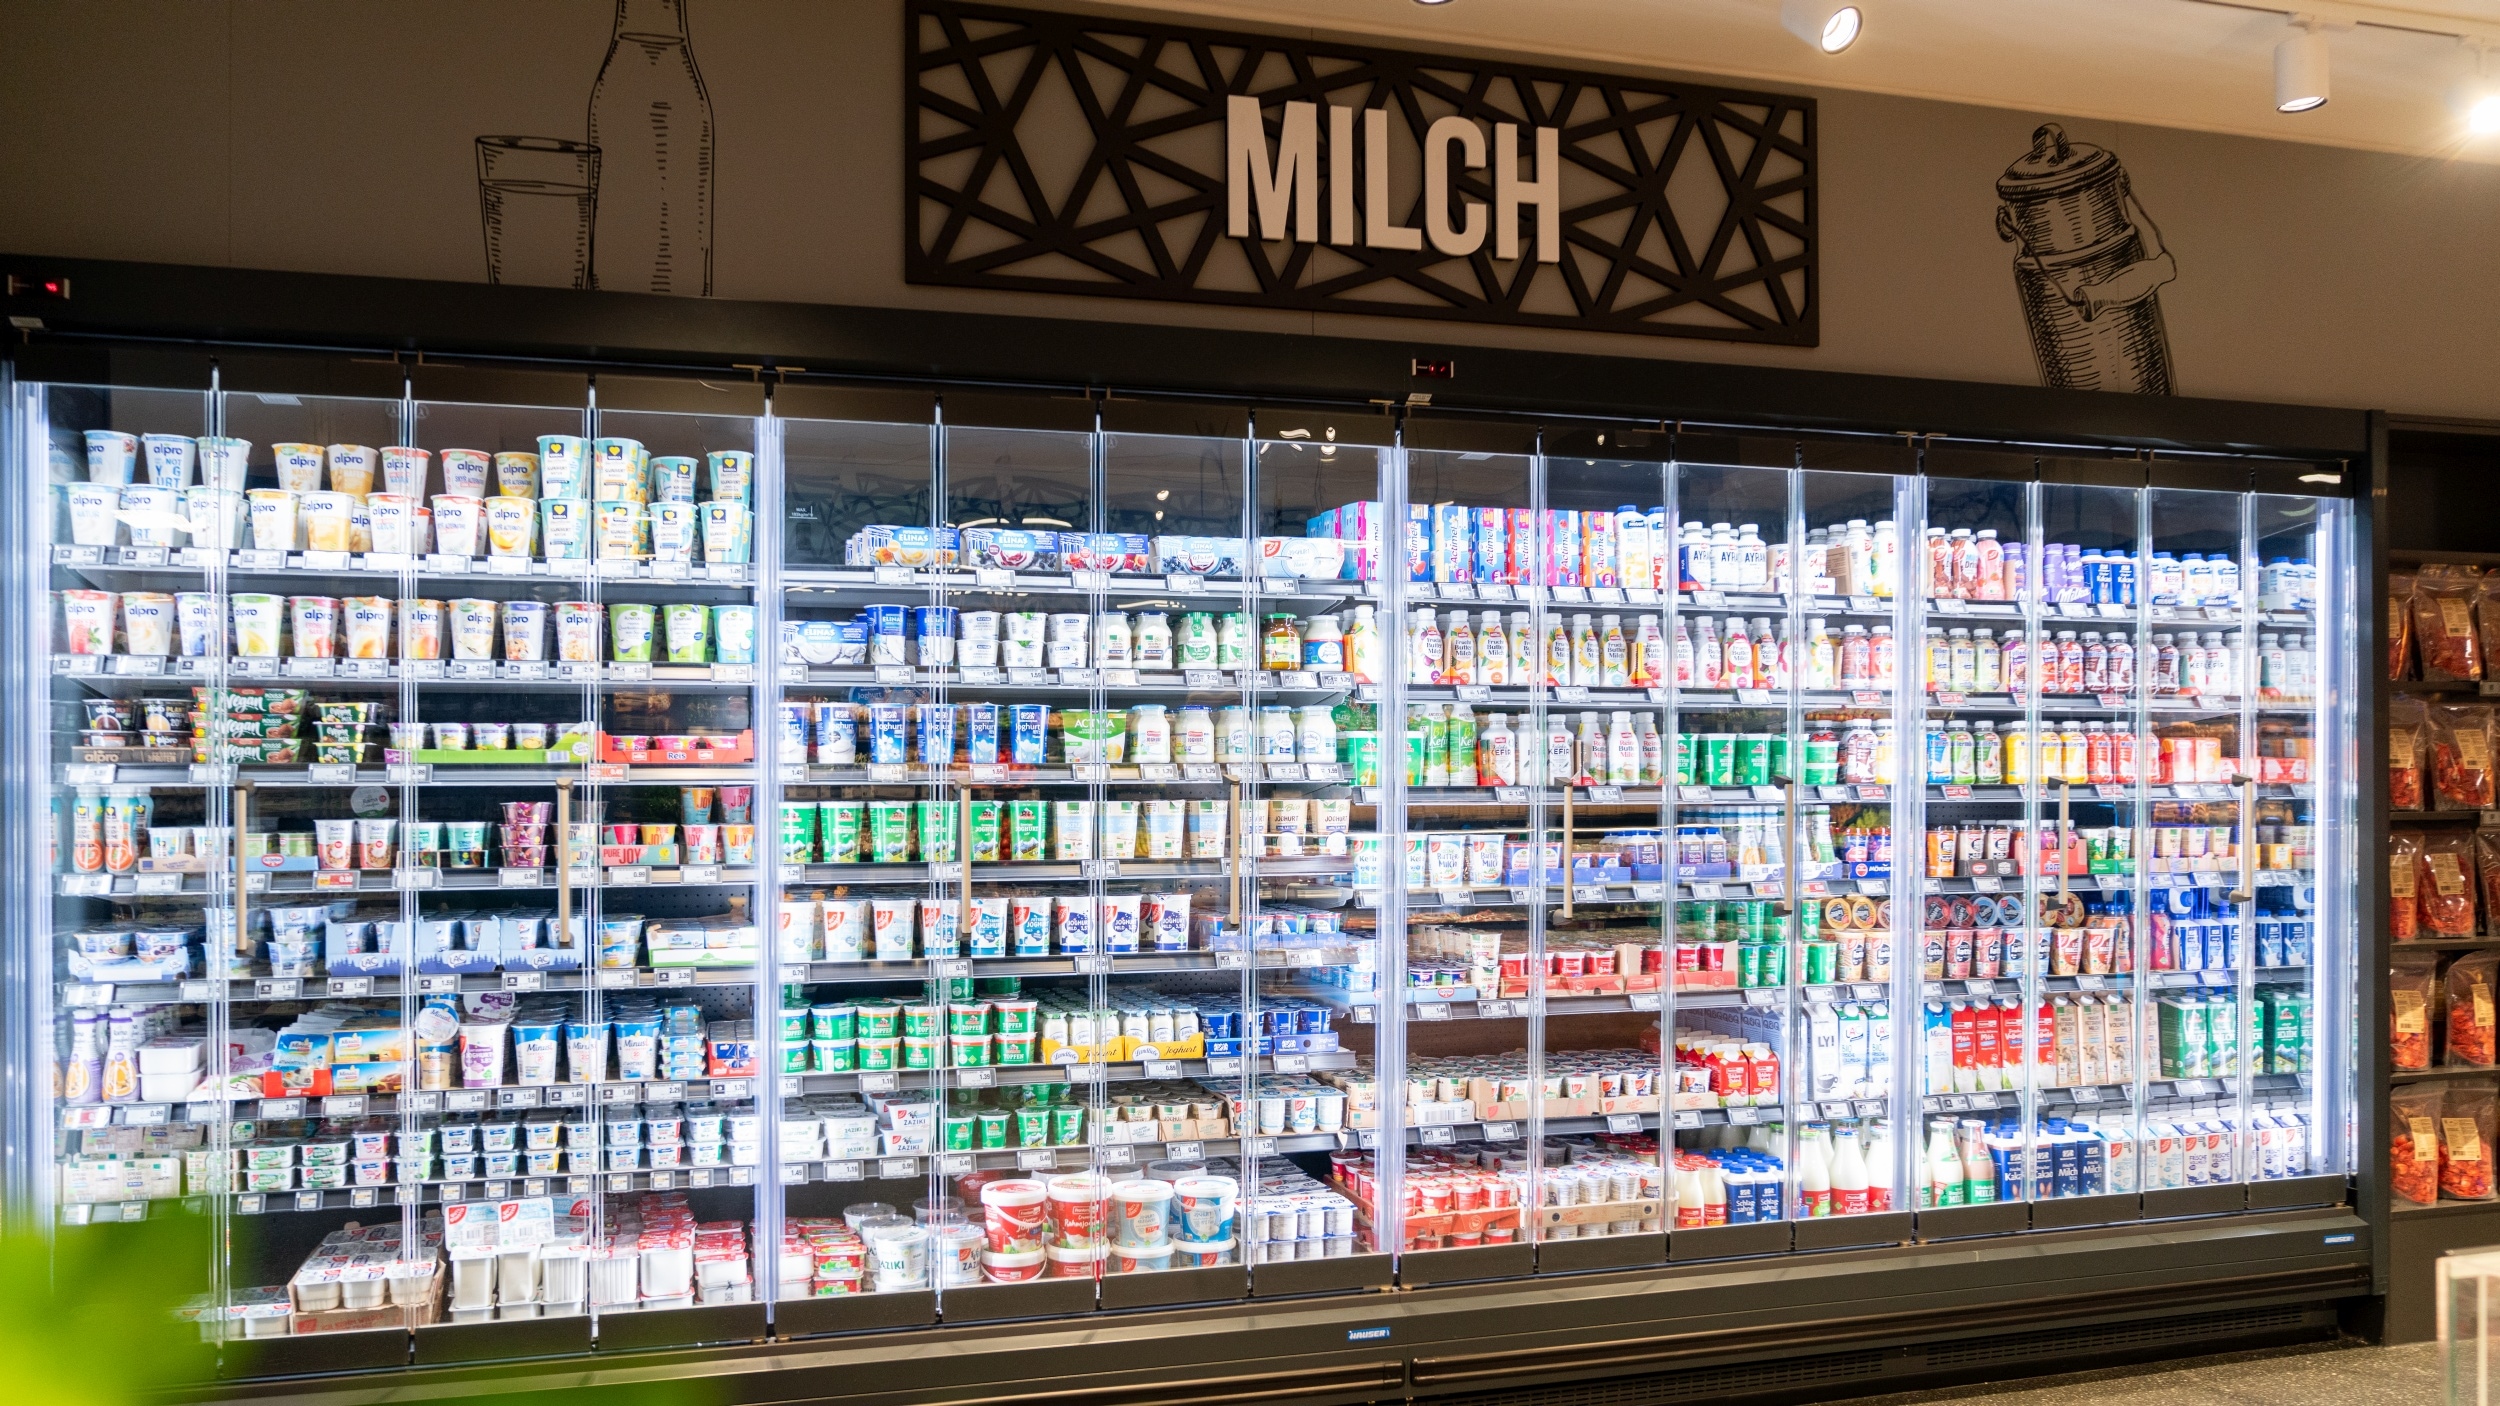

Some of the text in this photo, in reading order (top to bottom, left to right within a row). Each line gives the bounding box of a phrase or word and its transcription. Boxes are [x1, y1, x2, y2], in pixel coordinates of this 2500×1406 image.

[1227, 94, 1560, 263] MILCH
[154, 443, 182, 456] alpro
[290, 455, 316, 468] alpro
[334, 453, 364, 465] alpro
[457, 461, 484, 473] alpro
[503, 464, 528, 475] alpro
[73, 494, 102, 506] alpro
[252, 502, 276, 513] alpro
[372, 506, 399, 517] alpro
[437, 507, 462, 518] alpro
[495, 509, 520, 519] alpro
[899, 534, 928, 543] ELINAS
[999, 536, 1028, 544] ELINAS
[1450, 526, 1459, 565] Actimel
[1486, 528, 1494, 566] Actimel
[1560, 530, 1568, 569] Actimel
[2055, 587, 2090, 603] Milka
[68, 603, 95, 614] alpro
[129, 606, 158, 617] alpro
[305, 610, 333, 621] alpro
[356, 610, 384, 621] alpro
[467, 613, 492, 623] alpro
[504, 614, 528, 623] alpro
[803, 628, 835, 637] ELINAS
[84, 751, 119, 763] alpro
[668, 751, 686, 760] Reis
[731, 795, 746, 807] JOY
[731, 834, 747, 846] JOY
[603, 848, 641, 864] PURE JOY
[1165, 1045, 1197, 1056] Joghurt
[2005, 1173, 2022, 1181] Kaka
[2058, 1168, 2078, 1177] Milch
[1350, 1329, 1387, 1340] HAUSER
